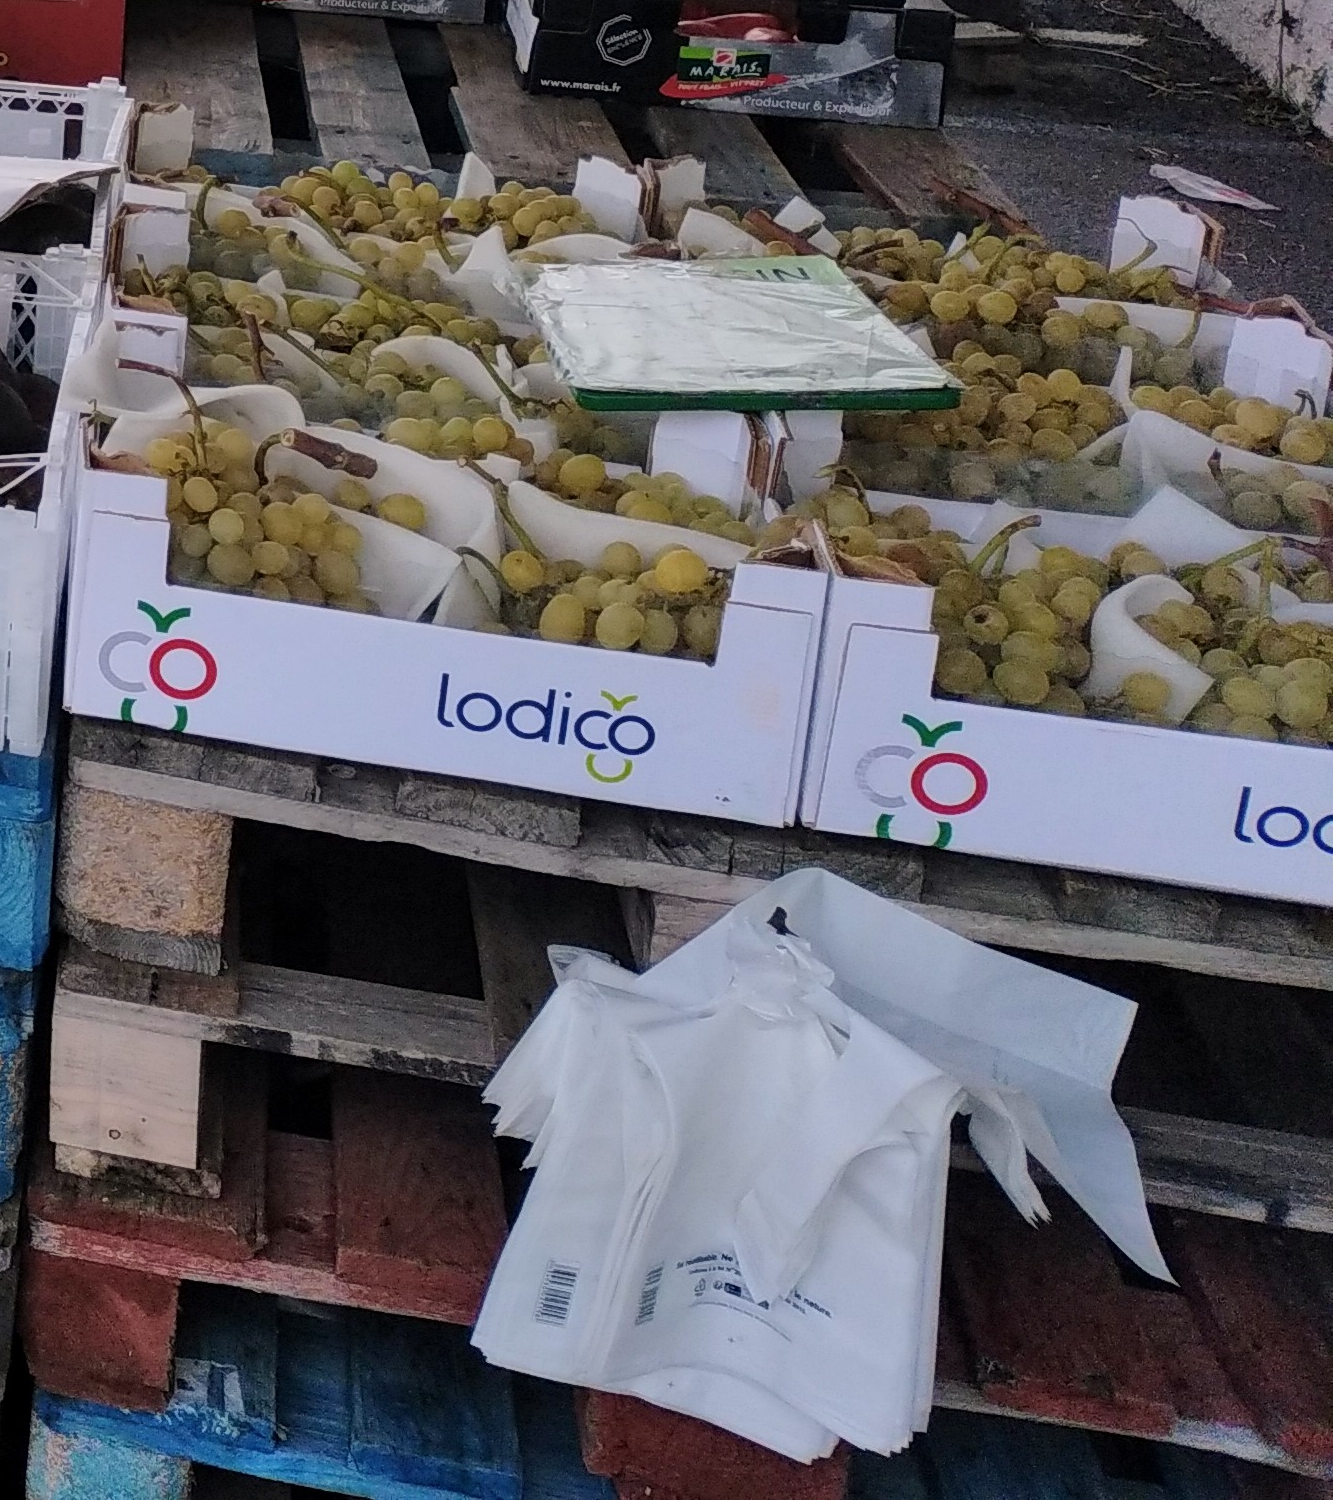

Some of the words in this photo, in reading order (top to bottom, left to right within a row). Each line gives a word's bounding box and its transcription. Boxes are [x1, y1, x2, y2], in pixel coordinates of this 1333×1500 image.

[381, 1, 390, 11] &
[689, 61, 759, 77] MARAIS
[540, 79, 622, 93] www.marais.fr
[743, 95, 811, 112] Producteur
[813, 101, 823, 111] &
